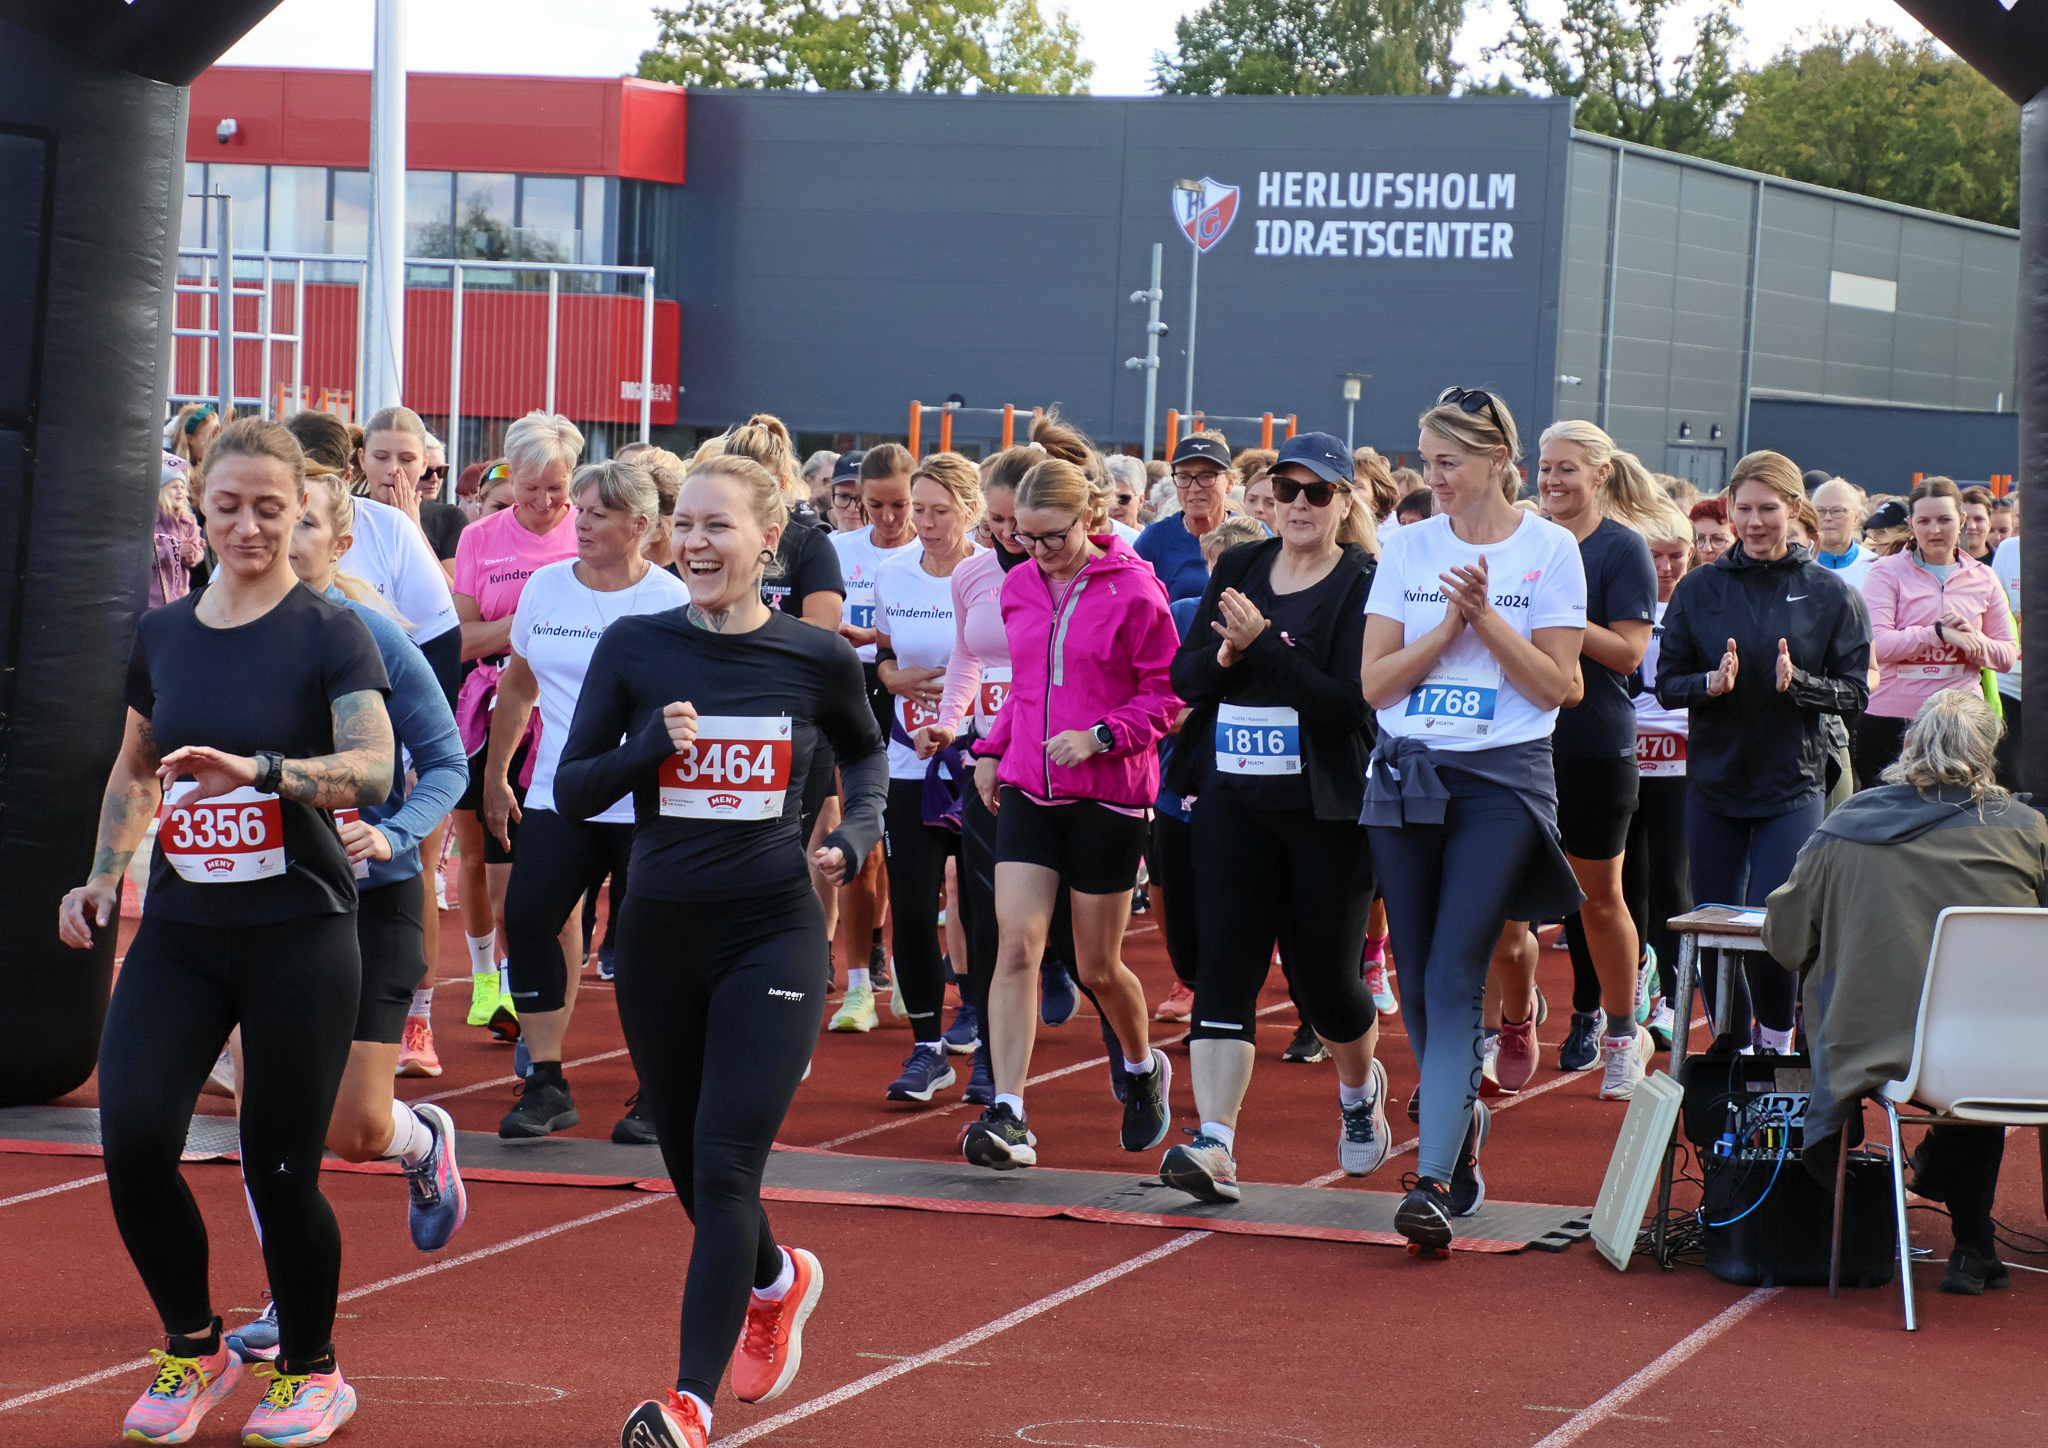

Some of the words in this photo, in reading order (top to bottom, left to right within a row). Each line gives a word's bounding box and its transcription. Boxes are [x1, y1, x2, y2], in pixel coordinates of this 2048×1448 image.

[1258, 172, 1516, 210] HERLUFSHOLM
[1254, 219, 1514, 258] IDRÆTSCENTER
[886, 602, 953, 619] Kvindemilen
[1404, 587, 1448, 604] Kvinde
[1495, 595, 1530, 609] 2024
[1417, 688, 1481, 716] 1768
[1225, 727, 1285, 755] 1816
[1636, 735, 1676, 758] 470
[676, 743, 776, 785] 3464
[711, 795, 739, 806] MENY
[171, 806, 266, 848] 3356
[207, 860, 233, 870] MENY
